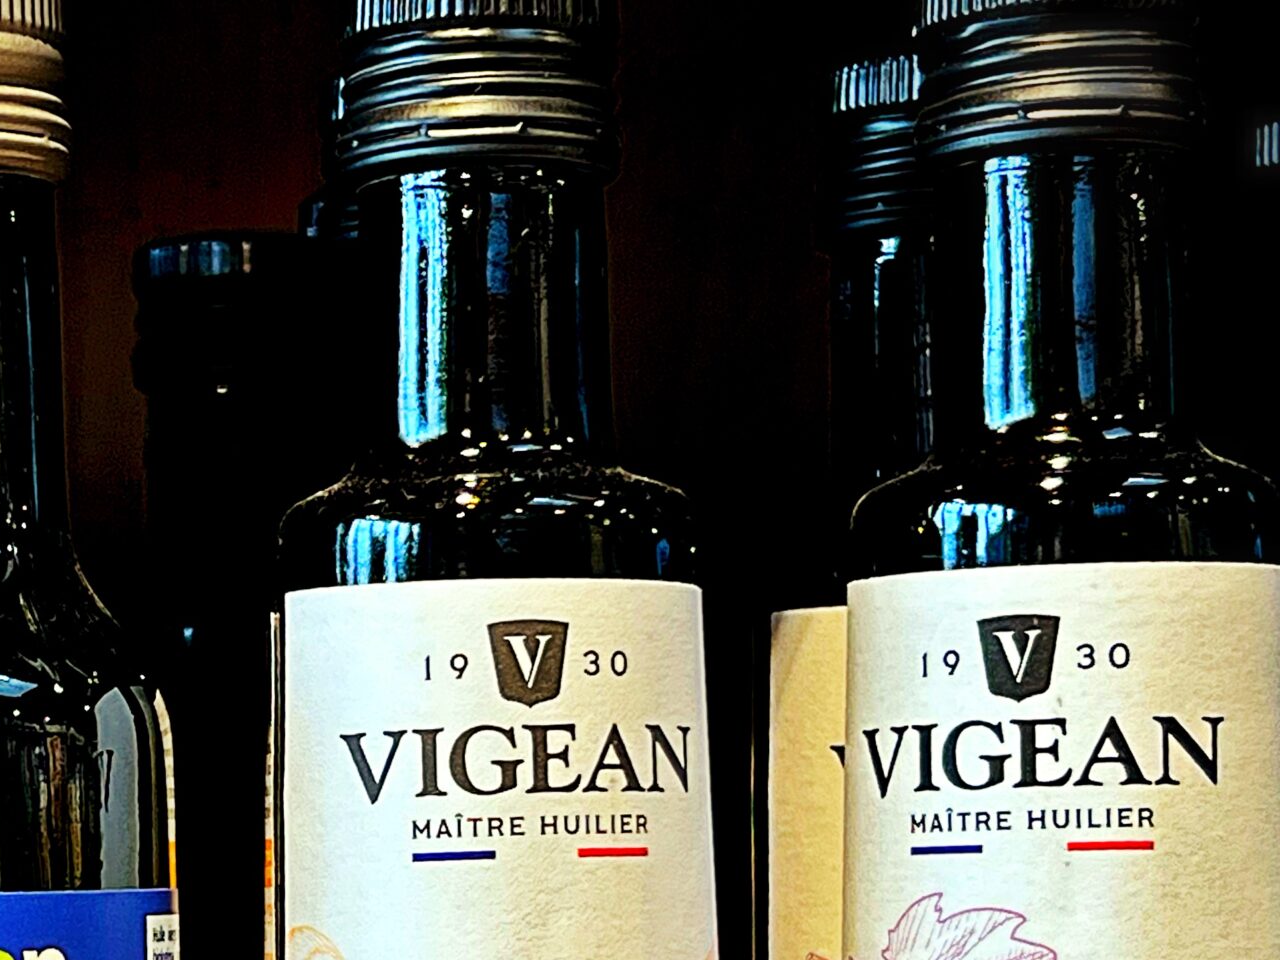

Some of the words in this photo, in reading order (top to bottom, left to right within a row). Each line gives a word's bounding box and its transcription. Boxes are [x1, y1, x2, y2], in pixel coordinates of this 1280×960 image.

[502, 634, 553, 689] V
[992, 629, 1042, 683] V
[339, 723, 691, 805] VIGEAN
[862, 715, 1224, 799] VIGEAN
[411, 813, 526, 840] MAÎTRE
[540, 813, 649, 836] HUILIER
[910, 807, 1012, 834] MAÎTRE
[1027, 807, 1155, 830] HUILIER
